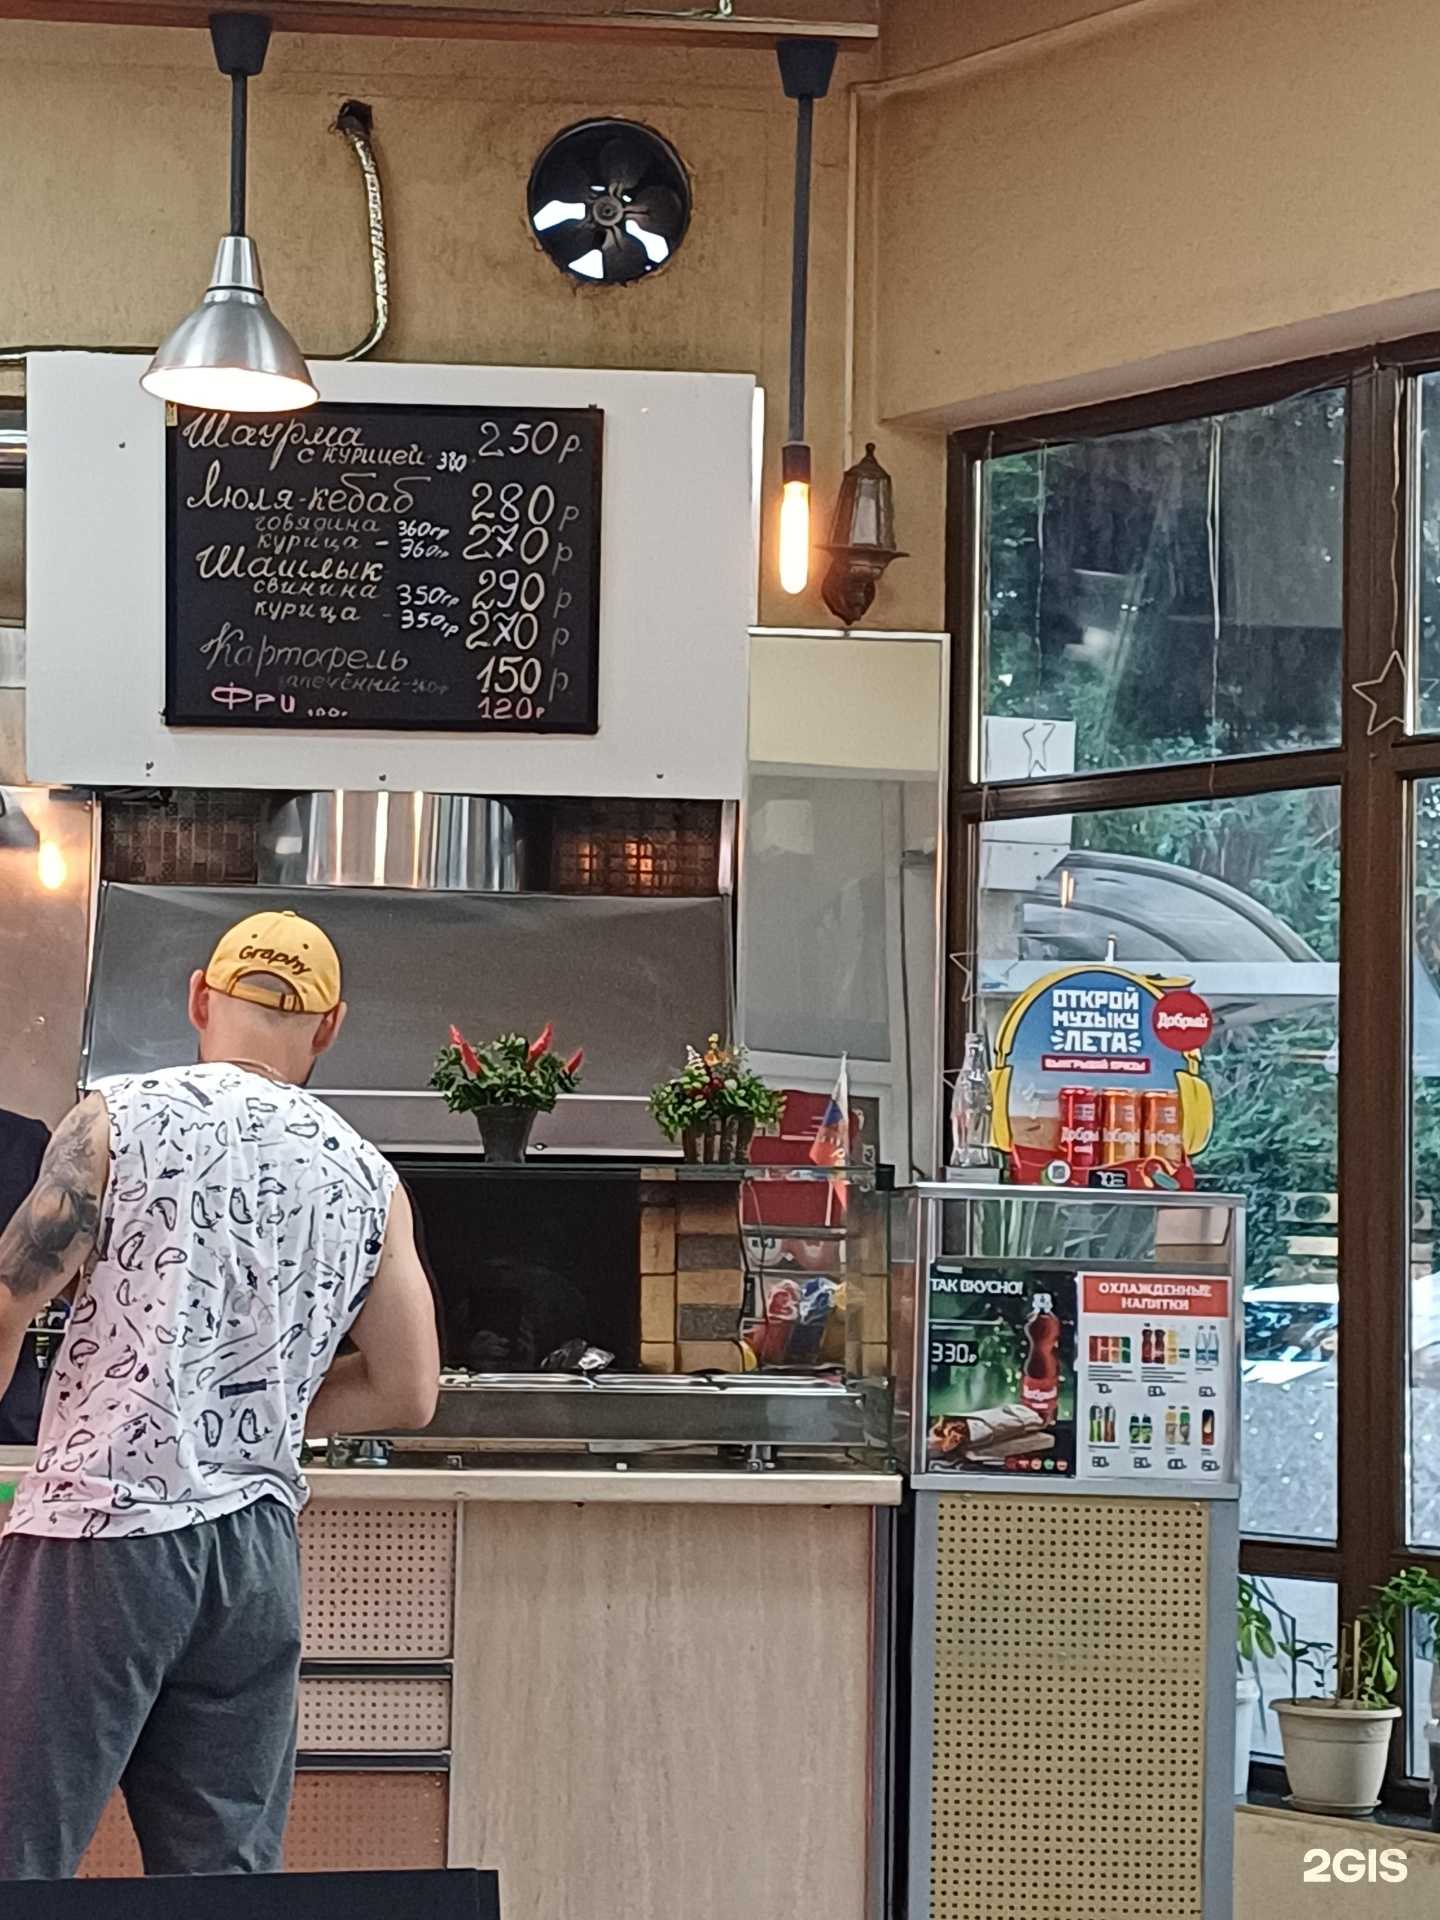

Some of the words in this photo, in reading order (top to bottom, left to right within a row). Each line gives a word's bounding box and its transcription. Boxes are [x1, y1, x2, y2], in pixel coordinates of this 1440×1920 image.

[182, 412, 365, 471] Шаурма
[186, 459, 431, 514] Люля-кебаб
[255, 513, 380, 534] говядина
[257, 533, 361, 554] курица
[196, 544, 383, 581] Шашлык
[253, 578, 379, 599] свинина
[254, 600, 361, 622] курица
[200, 622, 409, 677] Картофель
[238, 945, 312, 976] Graphy
[1052, 986, 1139, 1010] ОТКРОЙ
[1052, 1010, 1139, 1030] МУЗЫКУ
[1064, 1029, 1128, 1053] ЛЕТА
[930, 1279, 958, 1292] ТАК
